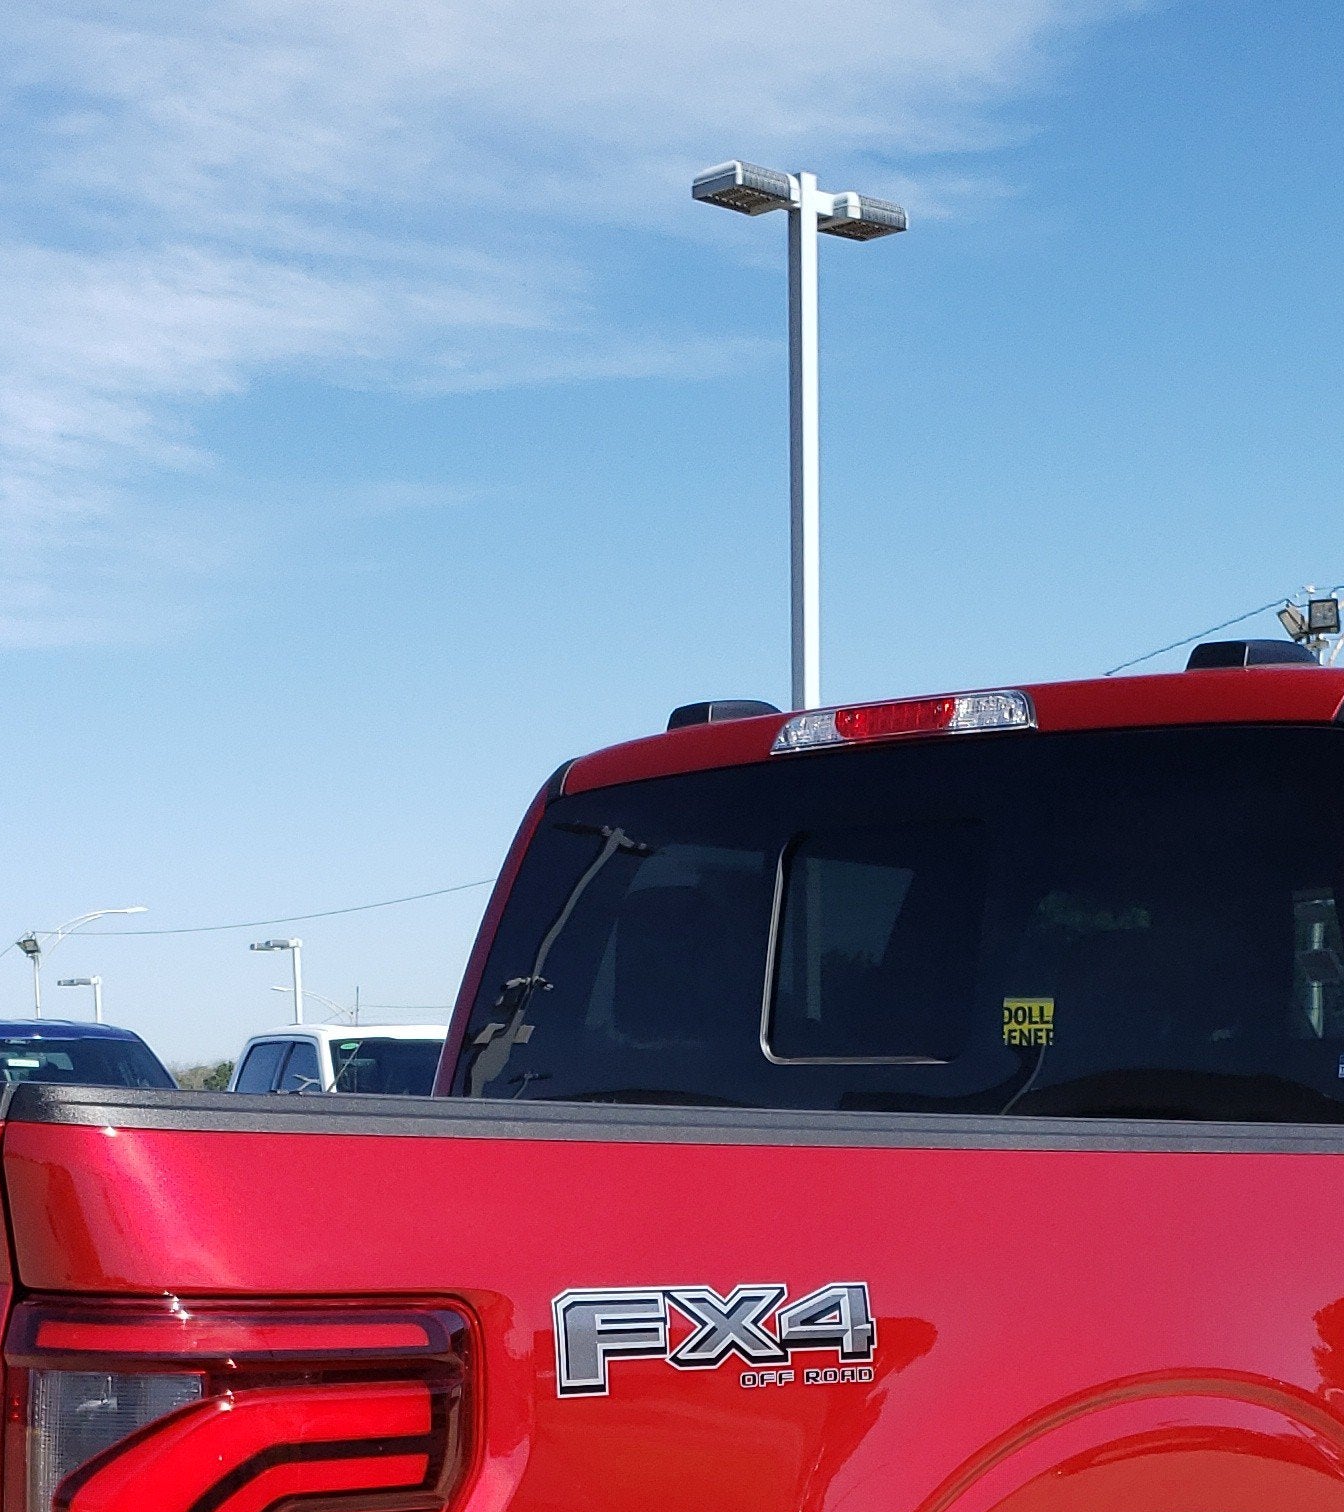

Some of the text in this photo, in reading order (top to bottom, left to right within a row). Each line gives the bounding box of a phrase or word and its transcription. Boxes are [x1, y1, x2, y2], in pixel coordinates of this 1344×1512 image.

[1002, 1028, 1054, 1048] ENER
[552, 1282, 878, 1399] FX4
[740, 1367, 874, 1388] OFF ROAD
